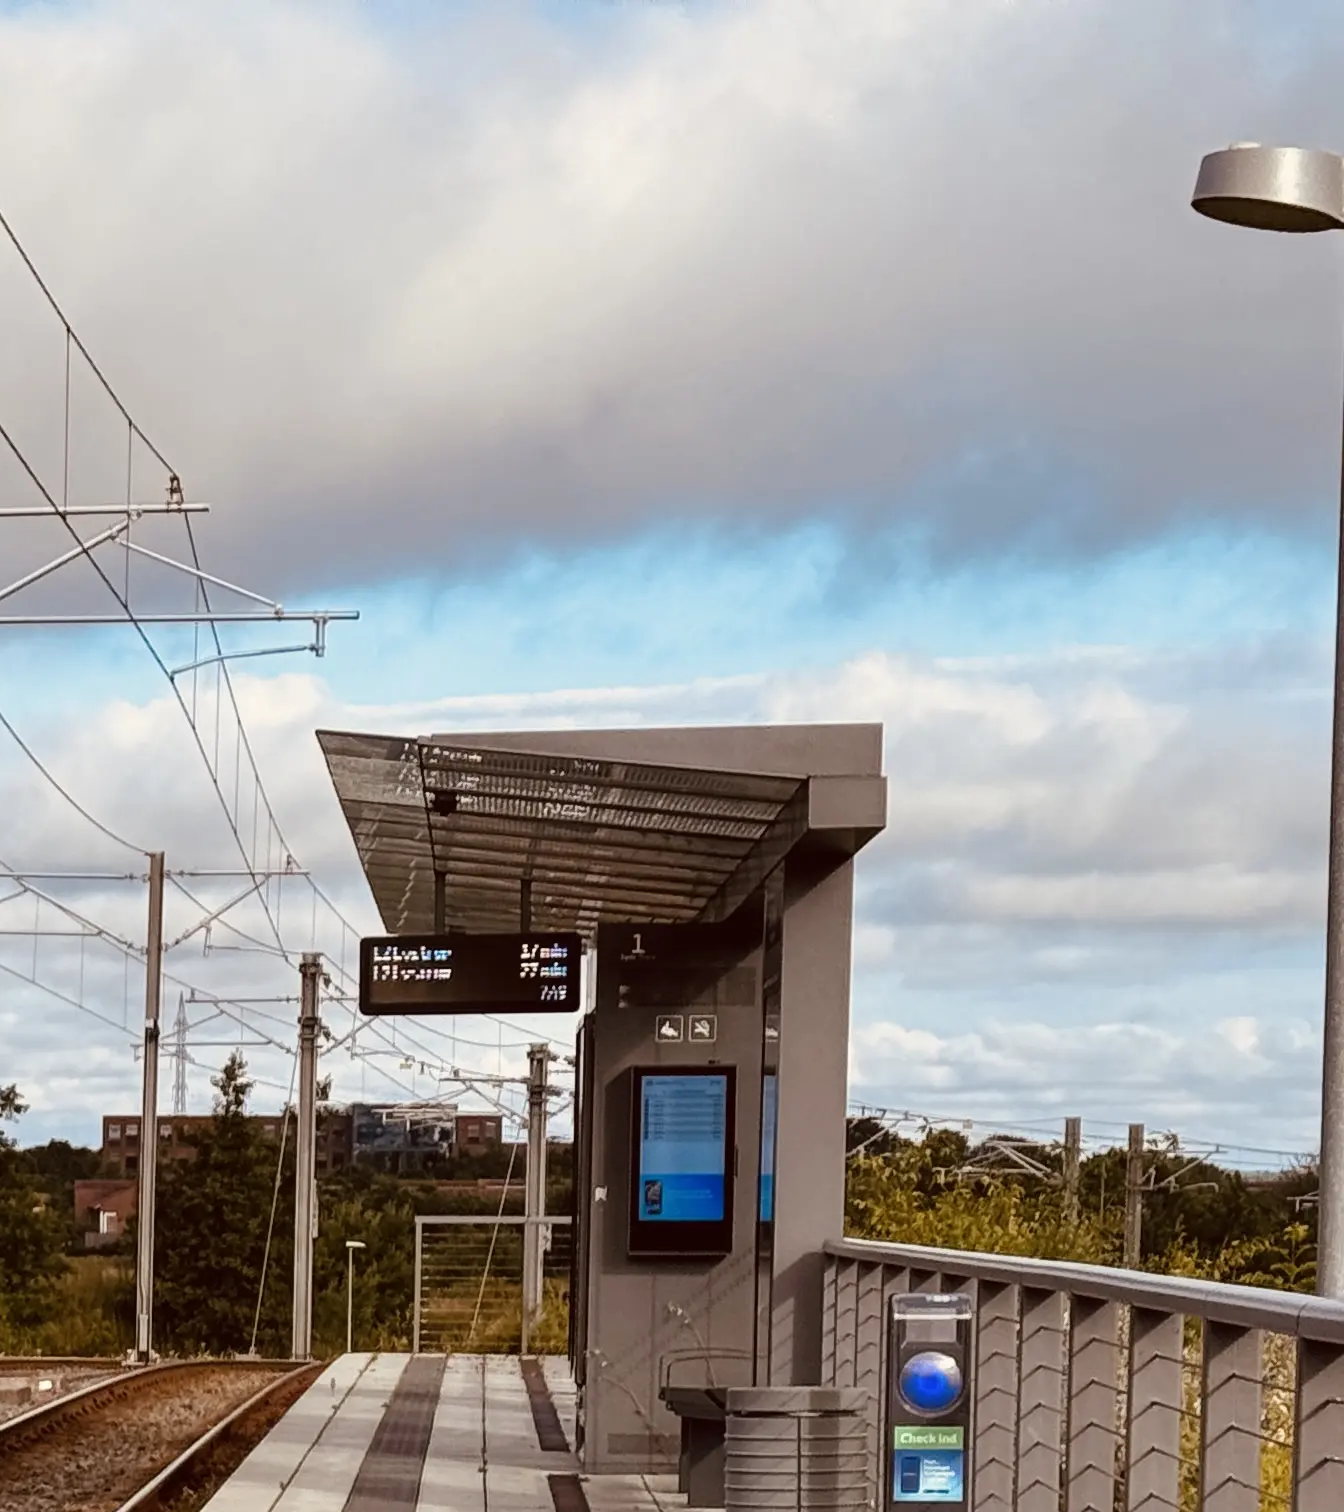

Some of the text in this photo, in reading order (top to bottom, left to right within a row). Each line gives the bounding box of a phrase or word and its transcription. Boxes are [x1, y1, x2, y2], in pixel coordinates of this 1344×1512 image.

[631, 933, 646, 954] 1
[900, 1432, 958, 1445] Check Ind
